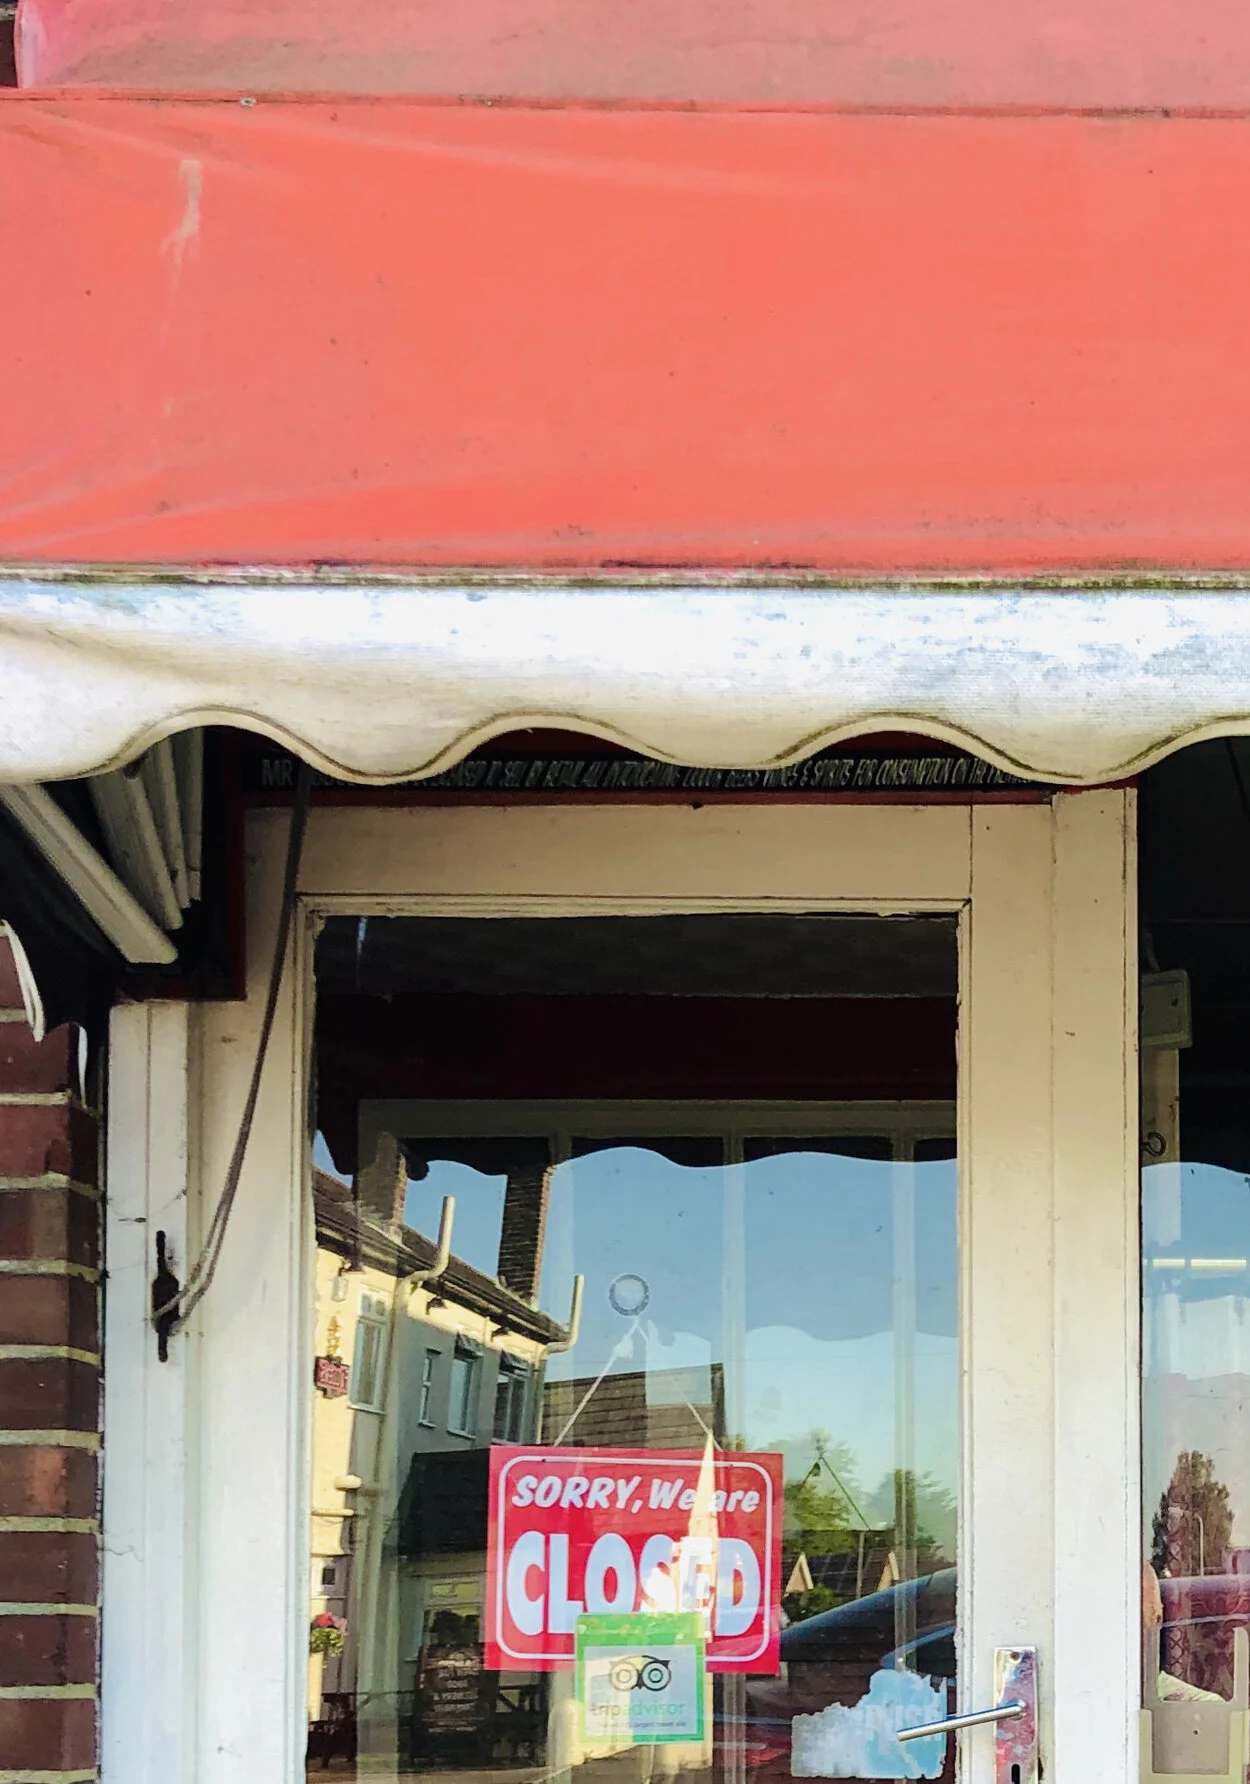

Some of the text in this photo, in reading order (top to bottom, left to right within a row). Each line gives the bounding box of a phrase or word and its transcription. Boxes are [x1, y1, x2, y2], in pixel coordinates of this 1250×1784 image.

[511, 1475, 760, 1514] SORRY, We are
